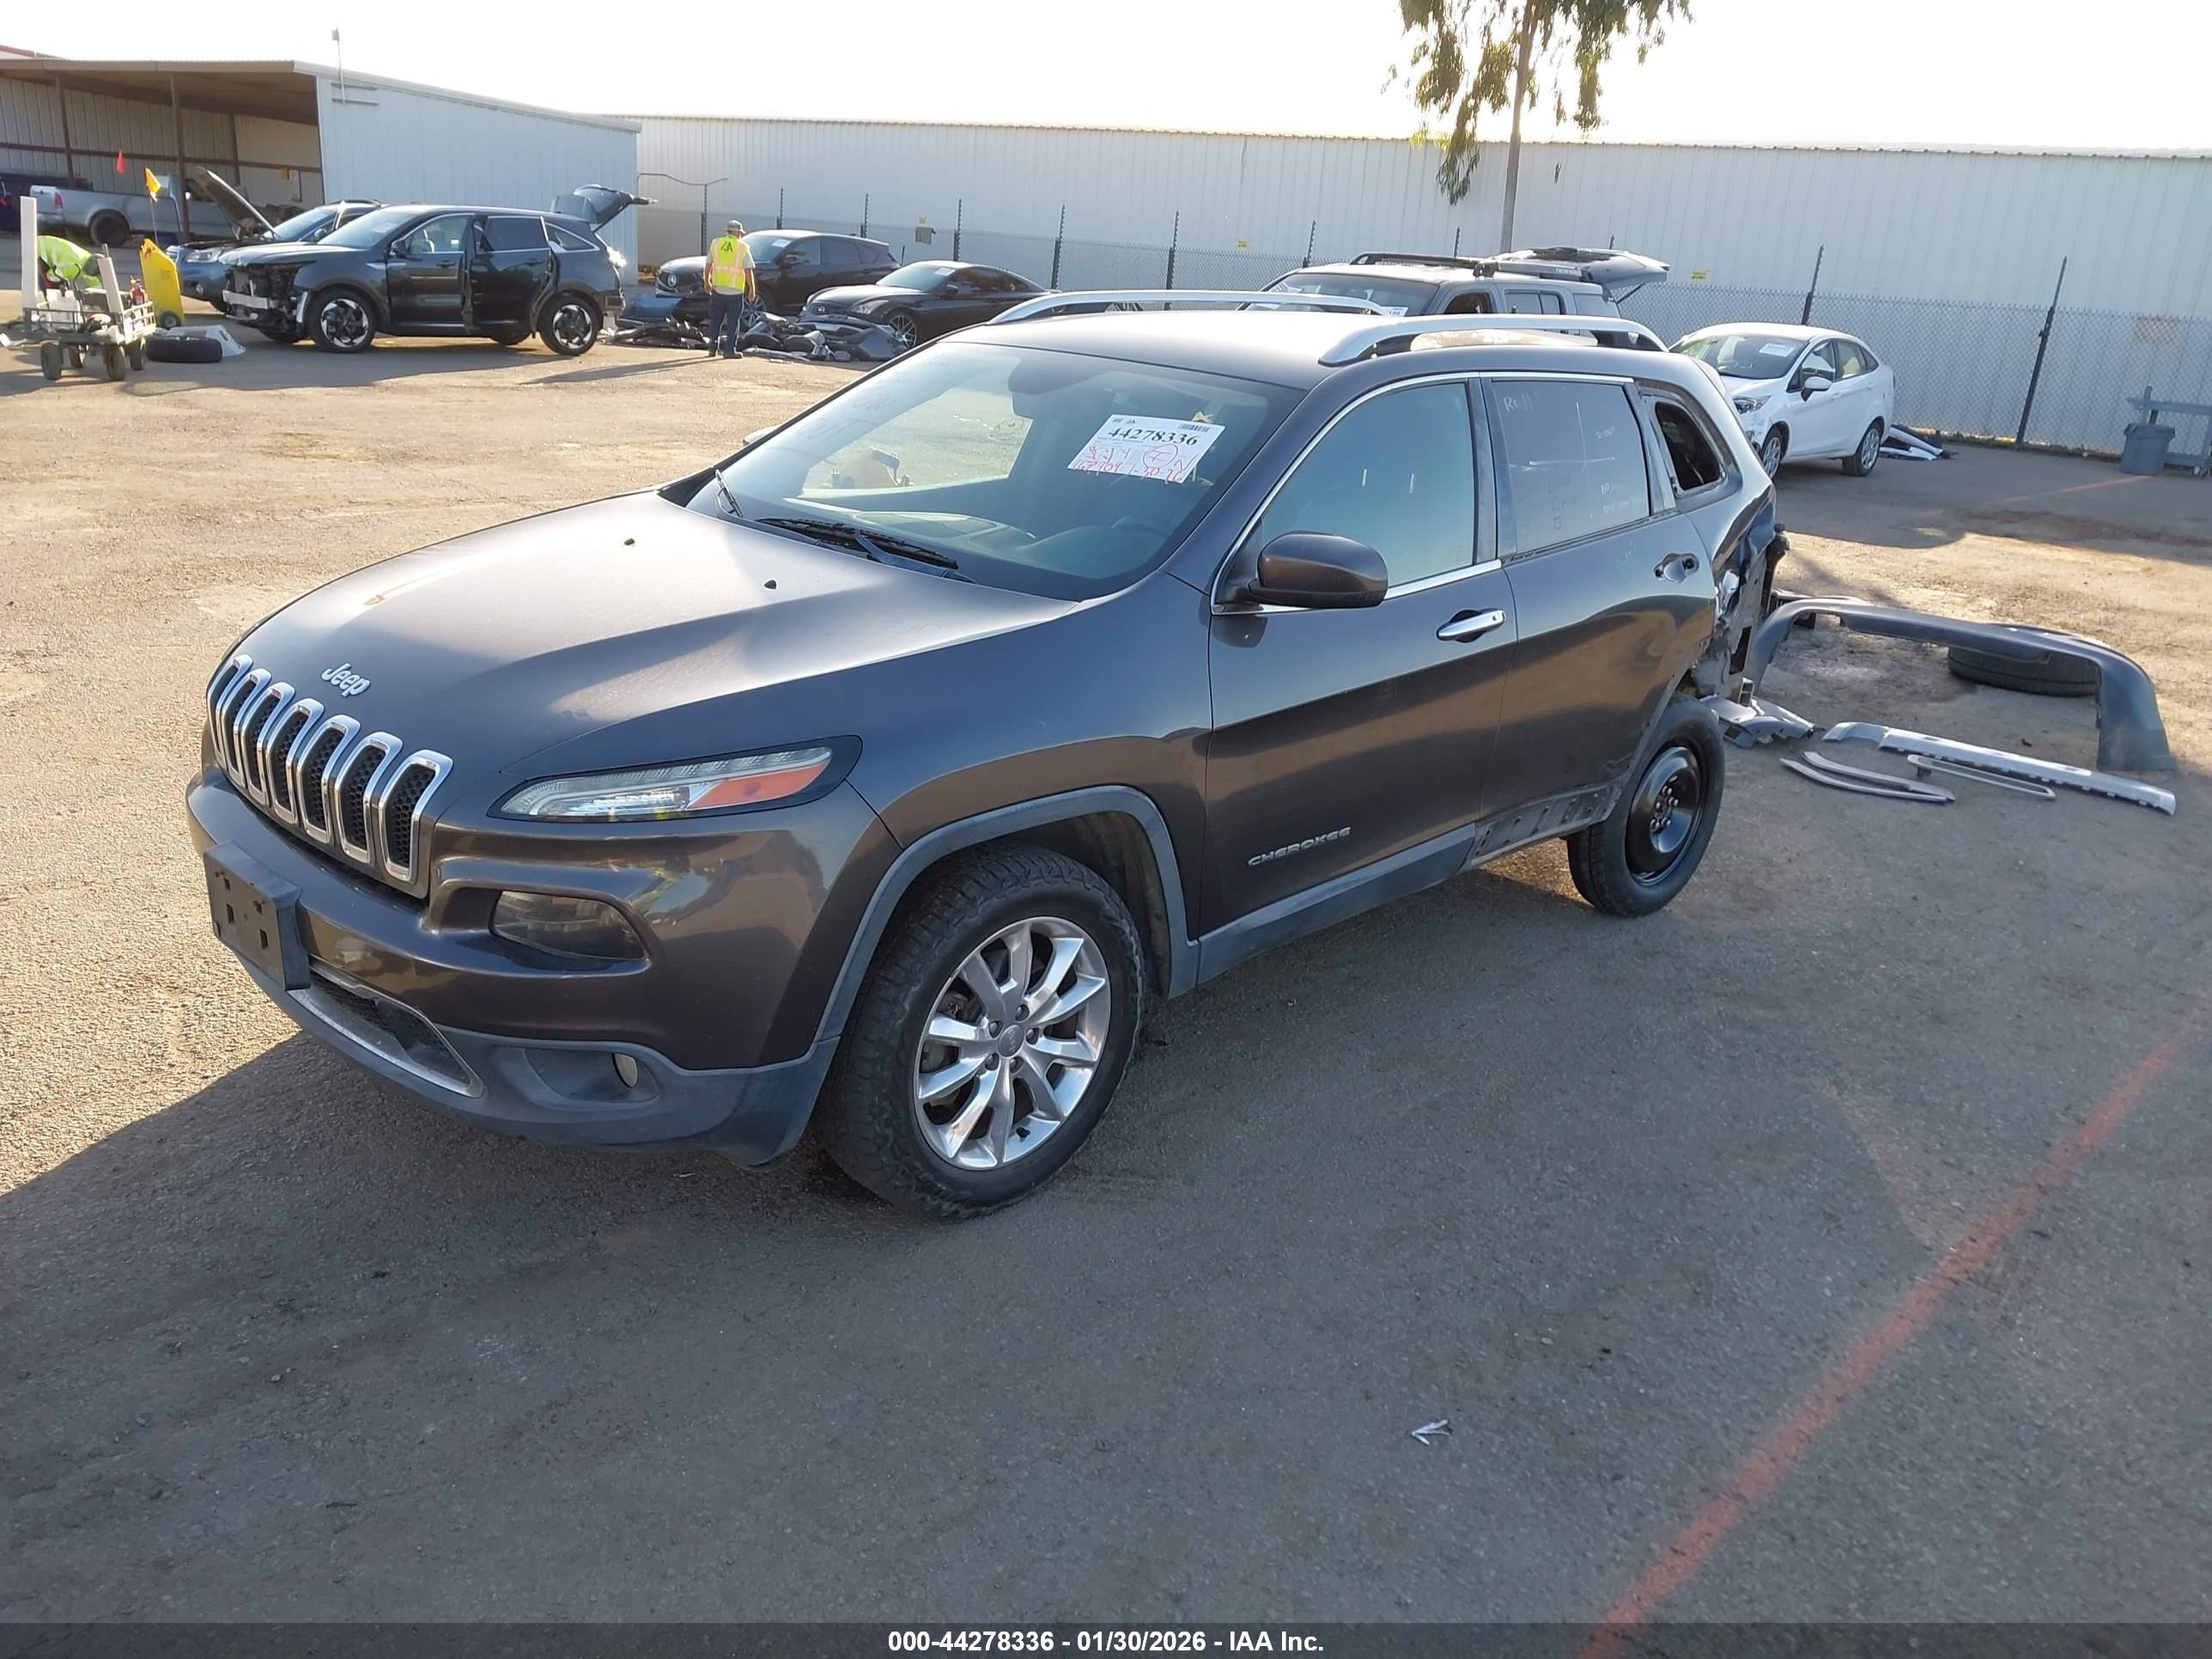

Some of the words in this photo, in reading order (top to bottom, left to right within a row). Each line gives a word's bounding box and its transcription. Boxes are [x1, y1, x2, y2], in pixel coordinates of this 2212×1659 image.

[1108, 427, 1199, 446] 44278336
[322, 663, 370, 696] Jeep
[1248, 827, 1352, 866] CHEROKEE
